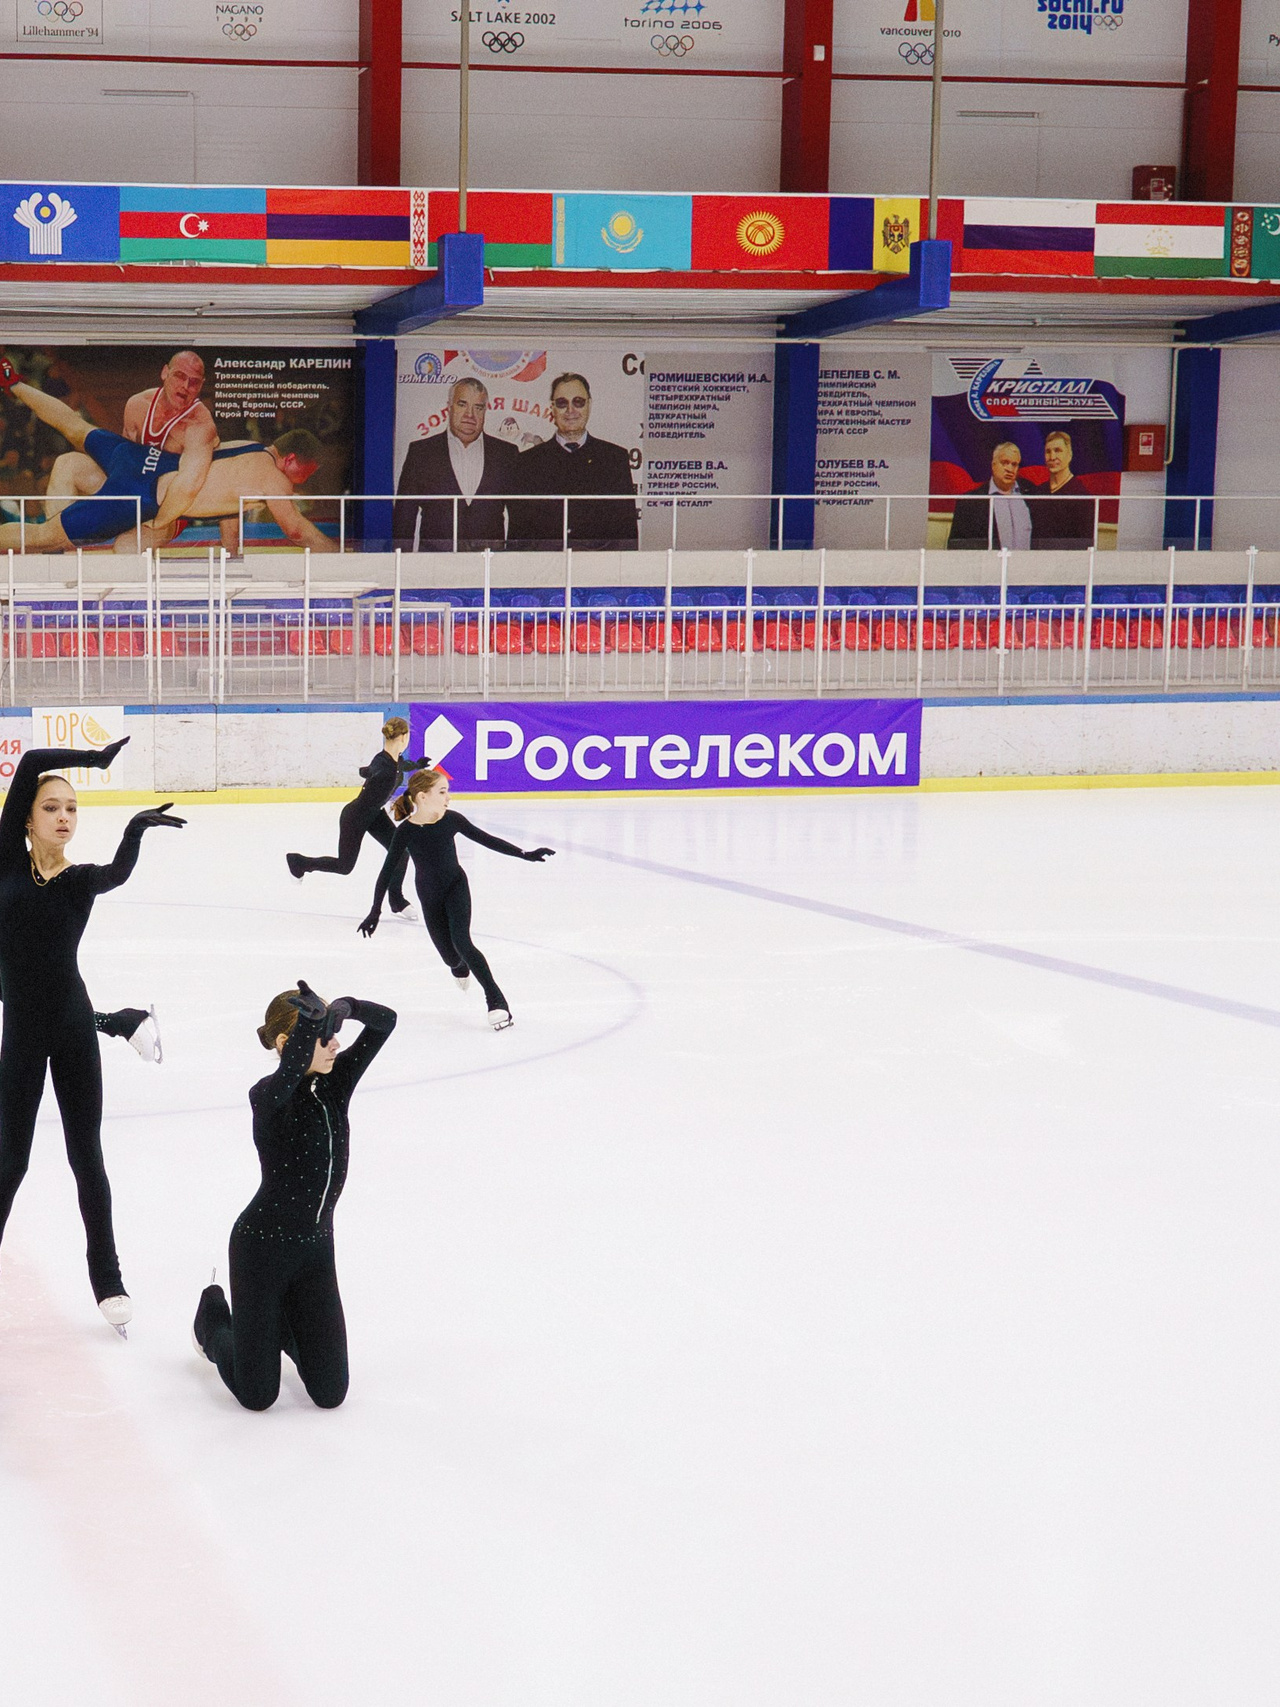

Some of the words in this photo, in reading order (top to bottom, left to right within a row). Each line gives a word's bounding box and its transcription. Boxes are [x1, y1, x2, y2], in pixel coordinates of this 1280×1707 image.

[216, 5, 264, 15] NAGANO
[451, 11, 483, 23] SLT
[487, 12, 521, 23] LAKE
[525, 13, 556, 25] 2002
[624, 17, 675, 29] torino
[680, 20, 723, 30] 2006
[1047, 14, 1093, 35] 2014
[880, 27, 933, 36] vancouver
[942, 29, 961, 38] 010
[214, 358, 286, 371] Александр
[289, 358, 352, 369] КАРЕЛИН
[215, 372, 273, 380] Трехкратный
[649, 372, 745, 383] РОМИШЕВСКИЙ
[747, 373, 772, 383] И.А.
[873, 370, 885, 379] С.
[887, 370, 901, 379] М.
[215, 381, 275, 389] олимпийский
[649, 384, 700, 392] СОВЕТСКИЙ
[818, 381, 877, 389] ЛИМПИЙСКИЙ
[986, 380, 1087, 393] КРИСТАЛЛ
[215, 391, 279, 400] Многократный
[649, 393, 731, 402] ЧЕТЫРЕХКРАТНЫЙ
[817, 391, 871, 399] ОБЕДИТЕЛЬ,
[215, 401, 241, 409] мира,
[242, 401, 278, 409] Европы,
[649, 403, 691, 411] ЧЕМПИОН
[215, 410, 242, 419] Герой
[417, 397, 505, 436] ЗОЛЯ
[512, 398, 555, 423] ШАЙ
[648, 412, 707, 421] ДВУКРАТНЫЙ
[648, 421, 715, 430] ОЛИМПИЙСКИЙ
[878, 418, 912, 426] МАСТЕР
[648, 431, 706, 439] ПОБЕДИТЕЛЬ
[141, 447, 162, 475] BUL
[648, 460, 703, 470] ГОЛУБЕВ
[705, 461, 729, 470] В.А.
[815, 460, 864, 469] ОЛУБЕВ
[867, 460, 889, 469] В.А.
[647, 471, 714, 480] ЗАСЛУЖЕННЫЙ
[815, 470, 875, 478] АСЛУЖЕННЫЙ
[815, 480, 842, 488] РЕНЕР
[474, 719, 907, 781] Ростелеком
